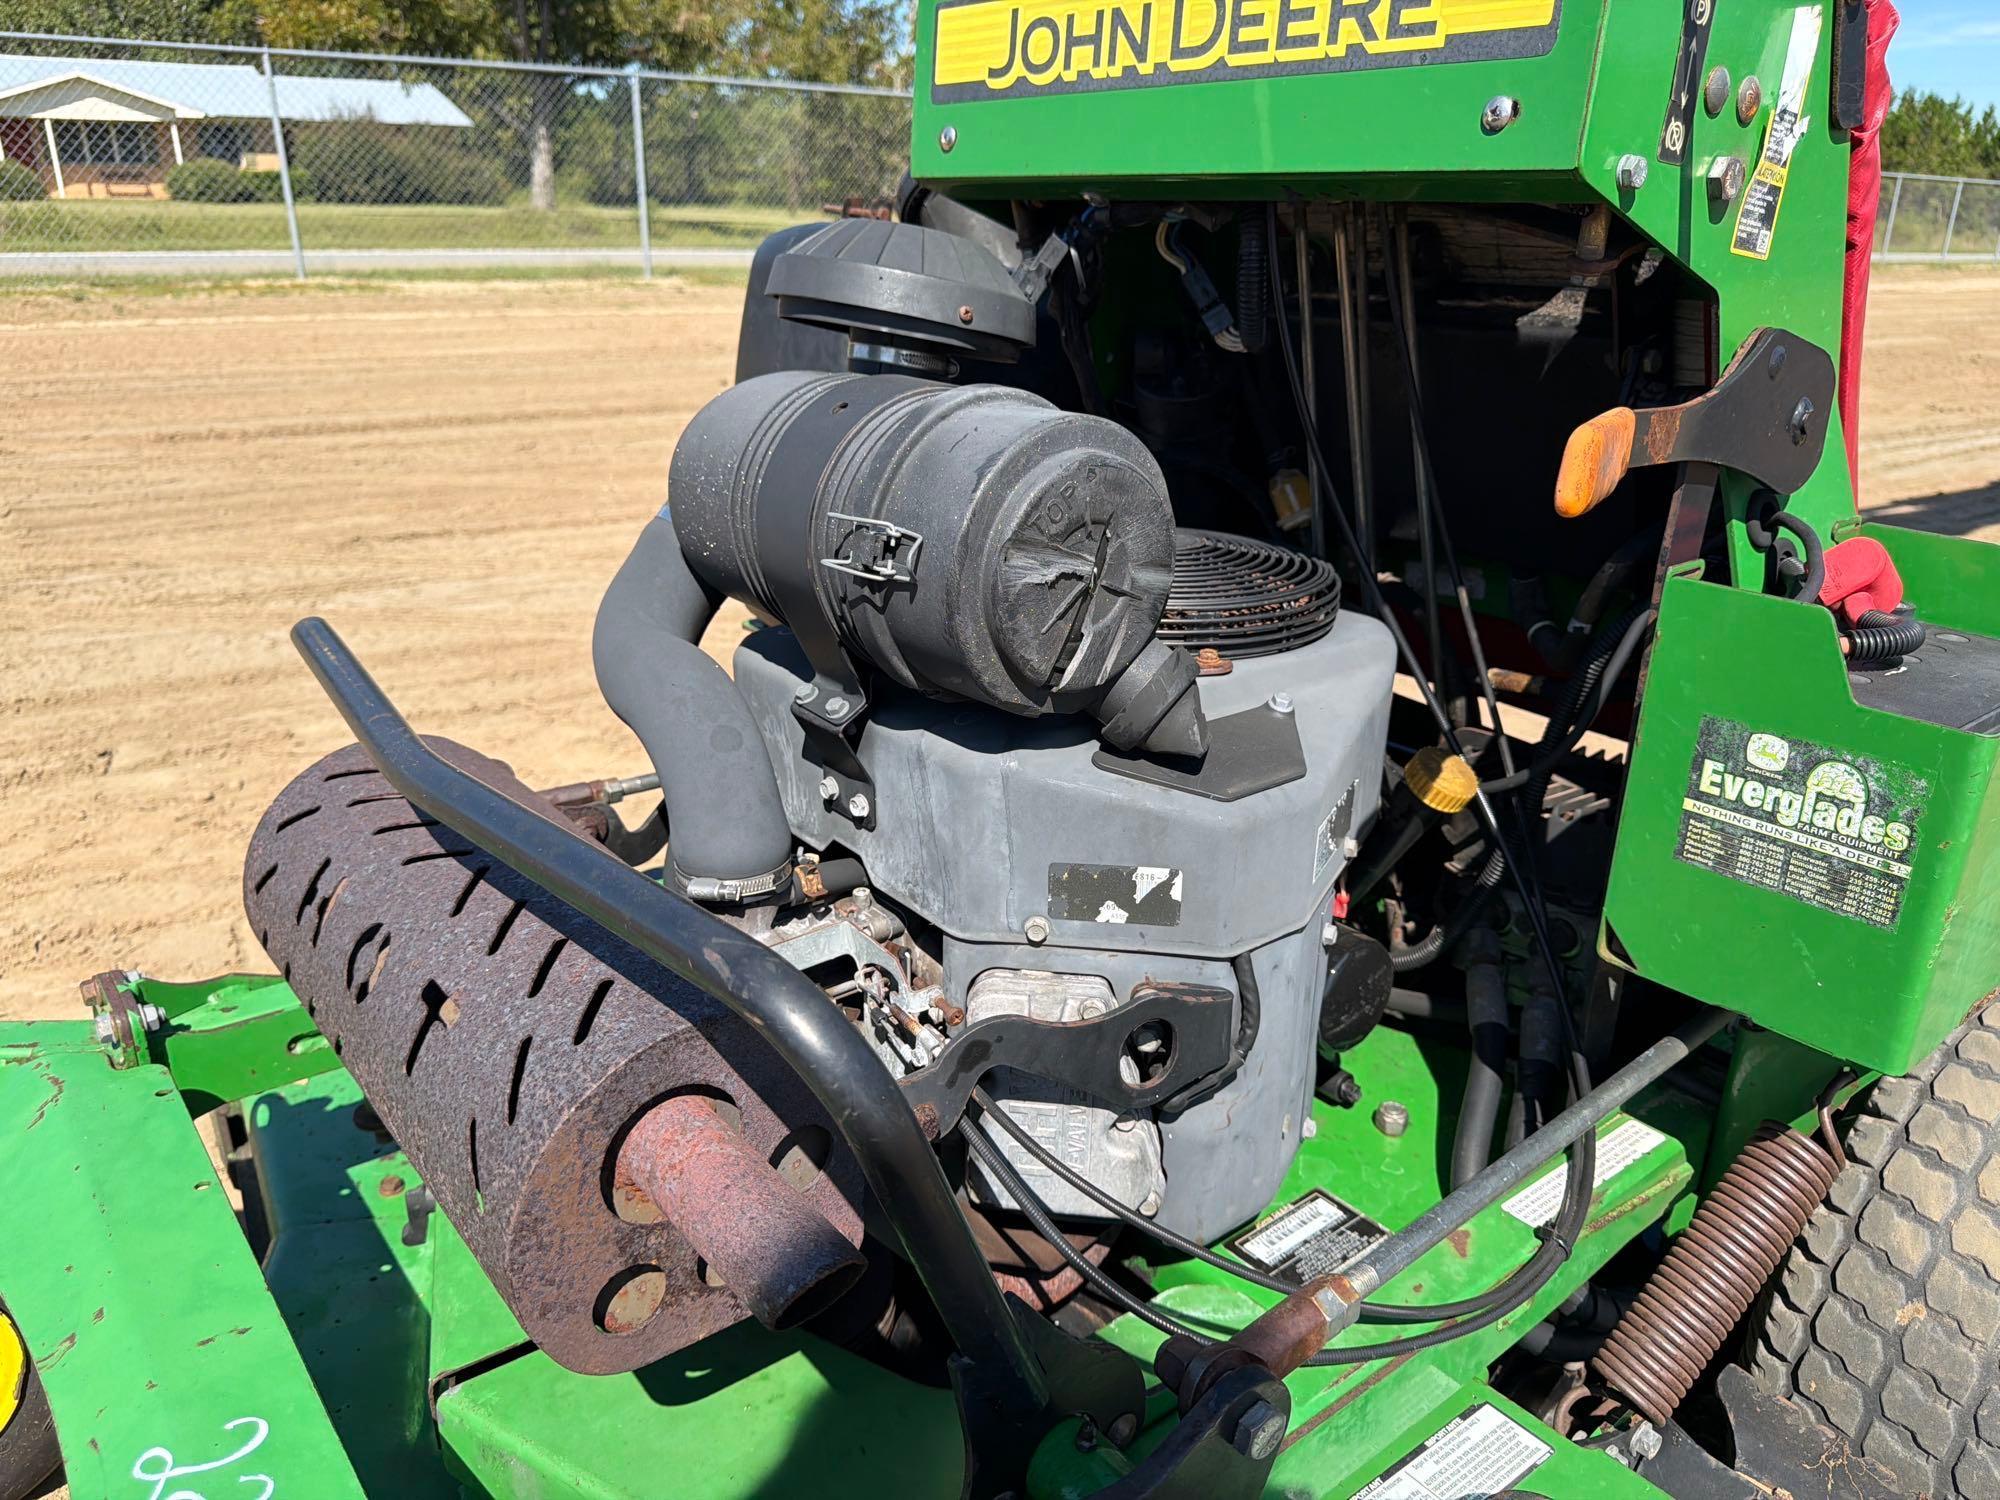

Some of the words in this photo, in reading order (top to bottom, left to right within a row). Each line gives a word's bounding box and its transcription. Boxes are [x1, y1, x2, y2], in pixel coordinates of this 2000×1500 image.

[987, 2, 1155, 86] JOHN
[1168, 0, 1442, 68] DEERE
[1692, 802, 1752, 827] NOTHING
[1755, 823, 1794, 840] RUNS
[1796, 835, 1829, 851] LIKE
[1832, 846, 1842, 856] A
[1699, 758, 1911, 852] Everglades
[1796, 822, 1829, 838] FARM
[1830, 833, 1901, 860] EQUIPMENT
[1424, 1416, 1464, 1449] IMPORTANTE
